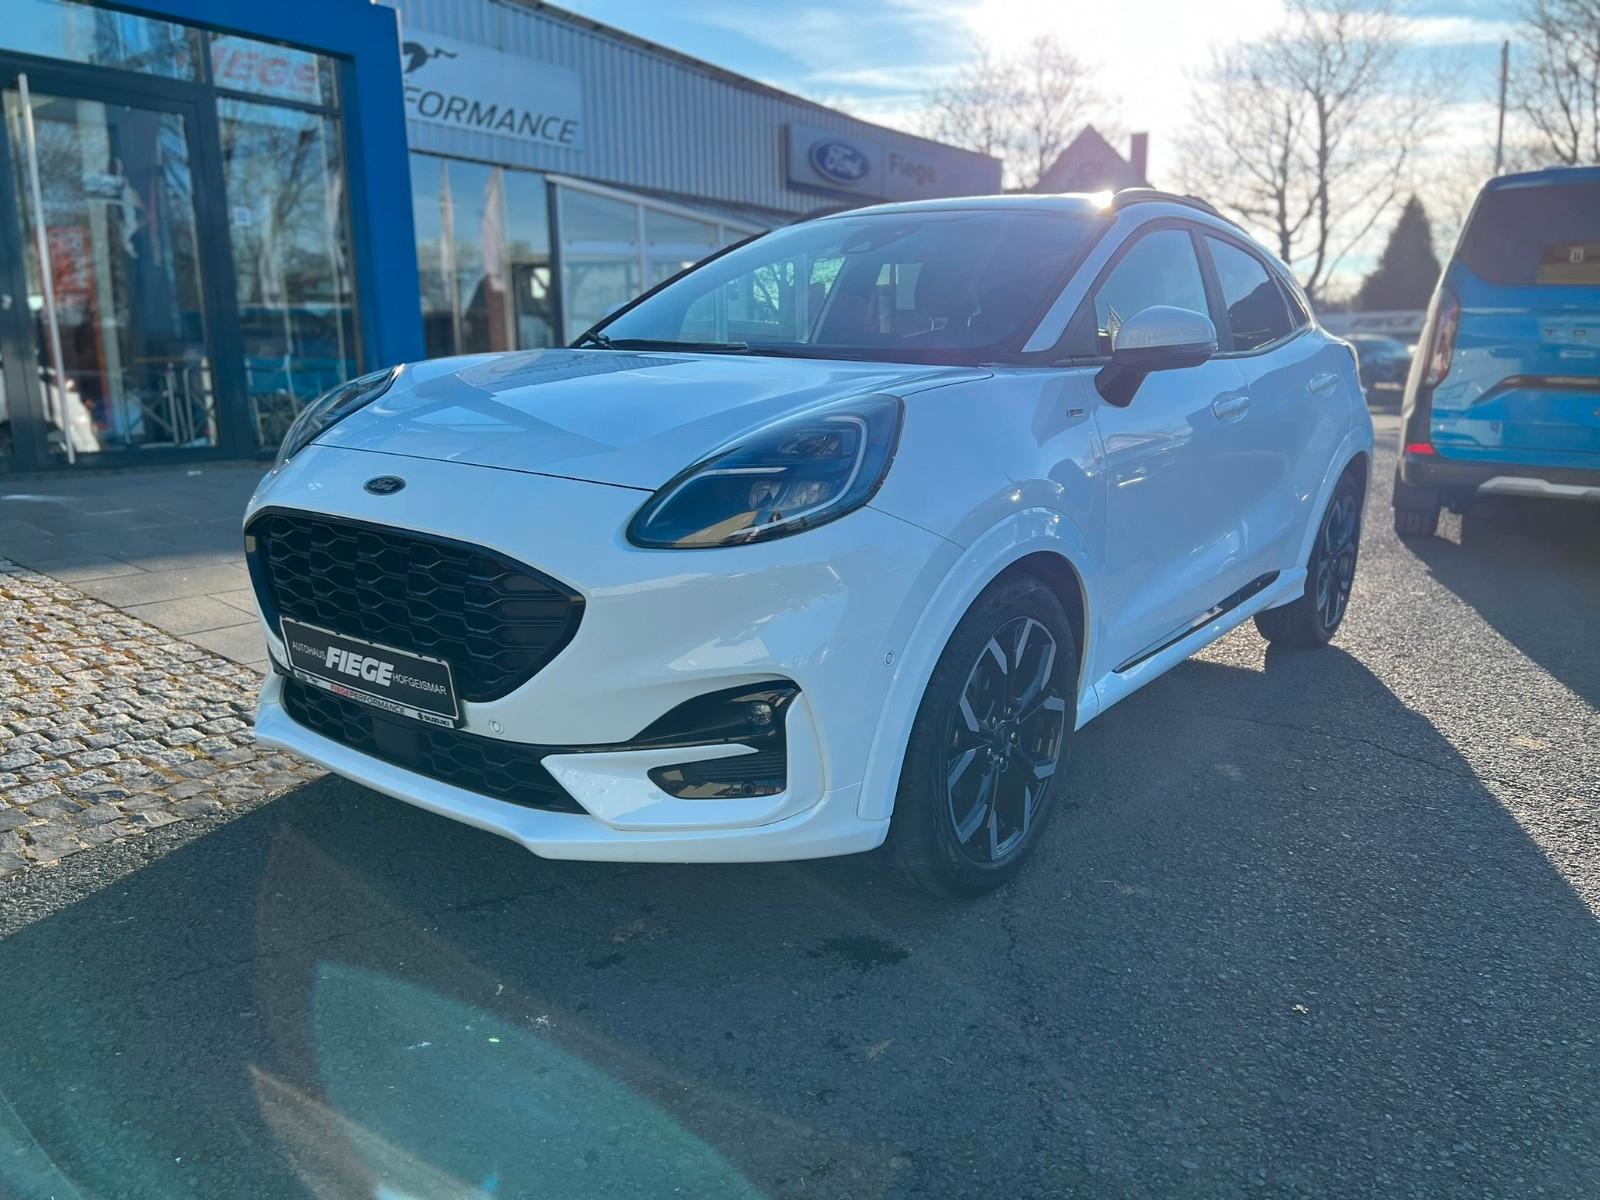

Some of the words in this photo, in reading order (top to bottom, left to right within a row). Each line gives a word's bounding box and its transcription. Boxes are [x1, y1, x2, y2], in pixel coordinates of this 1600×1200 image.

[889, 153, 937, 186] Fiege
[292, 641, 327, 660] AUTOHAUS
[325, 646, 394, 687] FIEGE
[393, 672, 447, 696] HOFGEISMAR
